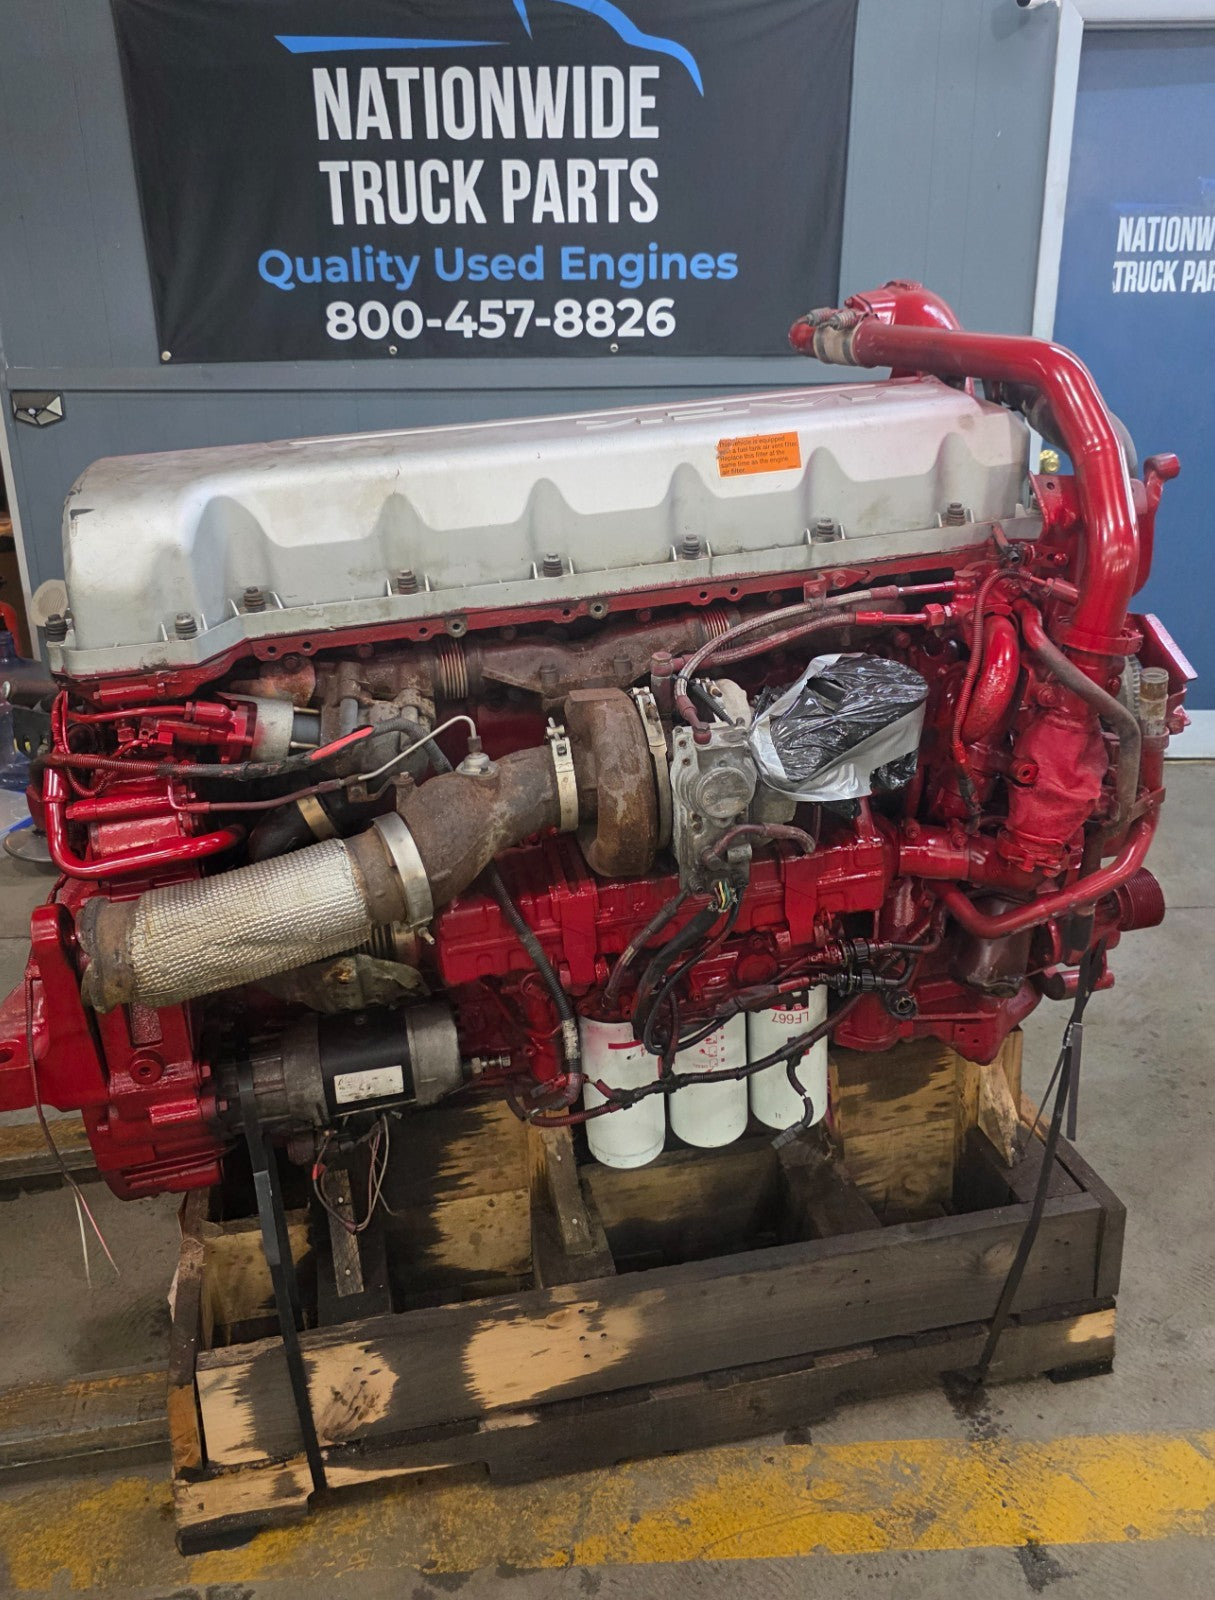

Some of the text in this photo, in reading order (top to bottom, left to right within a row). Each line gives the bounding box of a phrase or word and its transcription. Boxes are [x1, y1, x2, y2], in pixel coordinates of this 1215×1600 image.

[312, 65, 660, 140] NATIONWIDE
[318, 157, 660, 225] TRUCK PARTS
[258, 243, 739, 291] Quality Used Engines
[1112, 259, 1180, 293] TRUCK
[325, 298, 677, 341] 800-457-8826
[756, 450, 768, 458] filter
[759, 436, 786, 445] equipped
[771, 1011, 810, 1024] LF667
